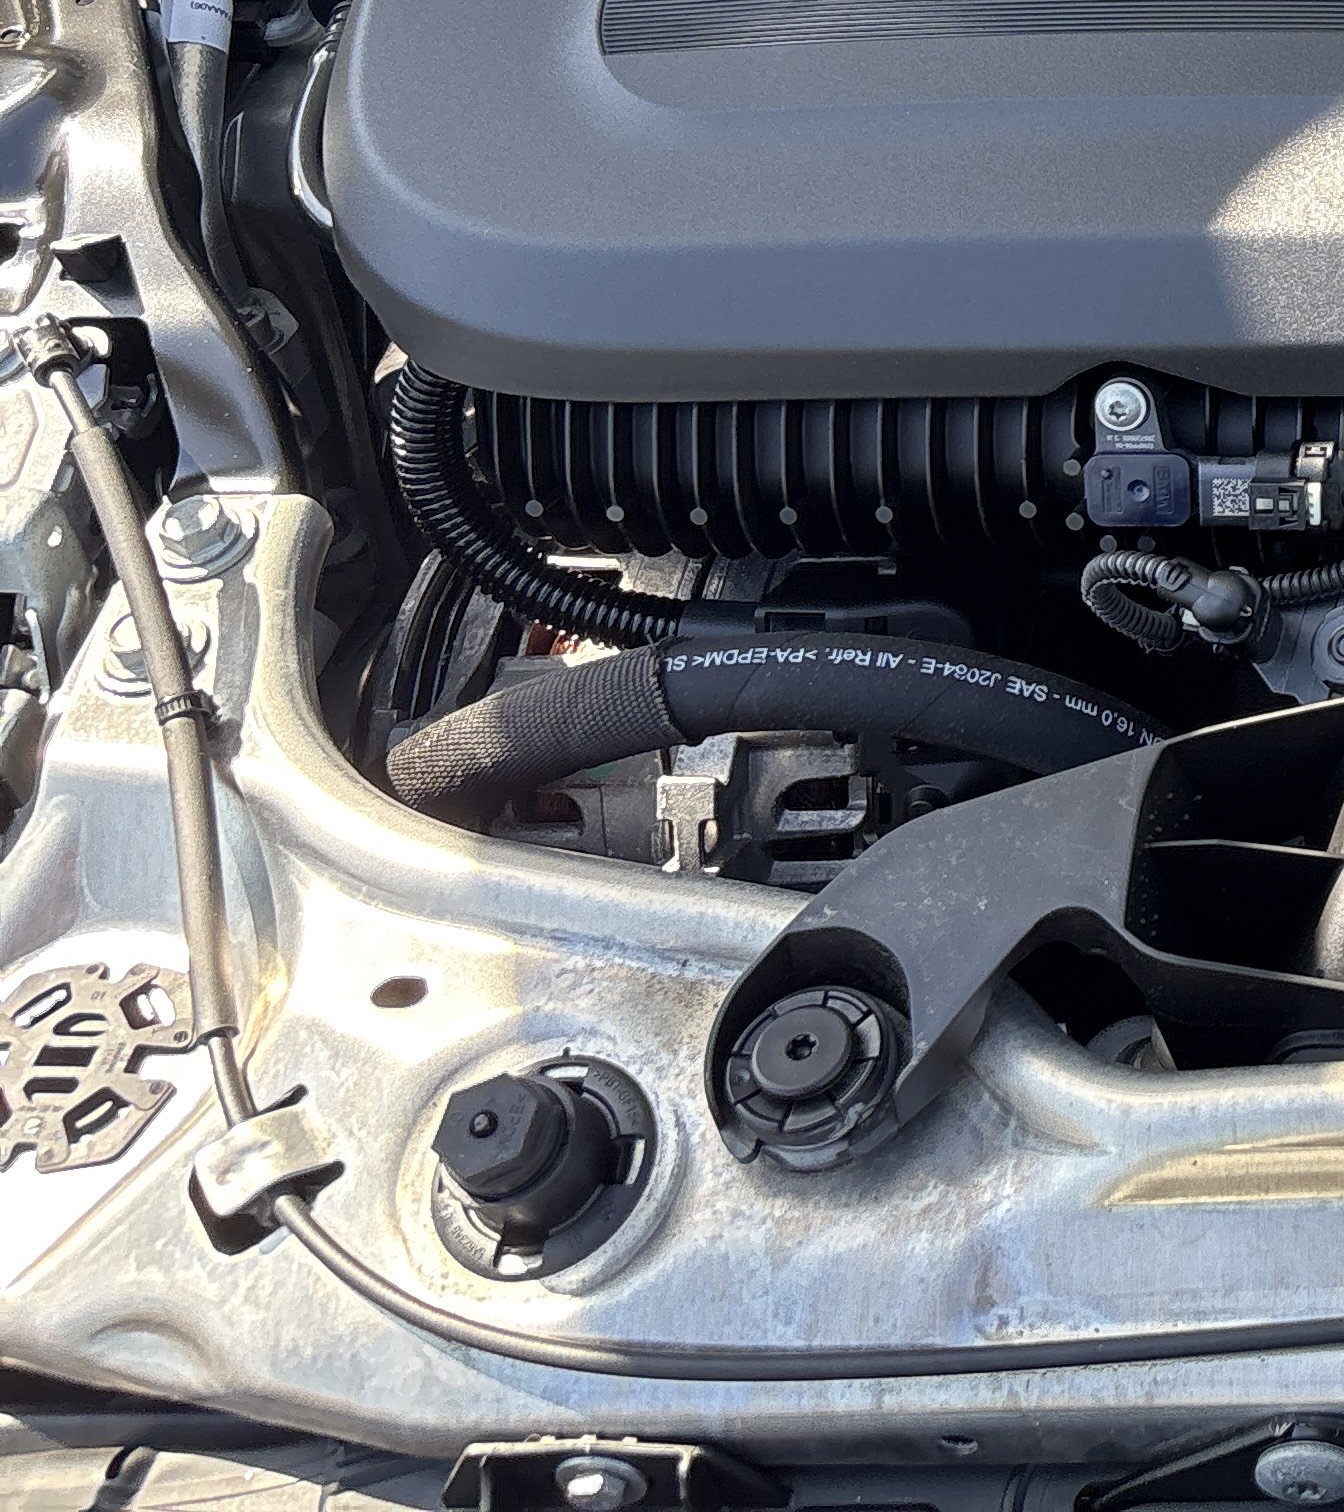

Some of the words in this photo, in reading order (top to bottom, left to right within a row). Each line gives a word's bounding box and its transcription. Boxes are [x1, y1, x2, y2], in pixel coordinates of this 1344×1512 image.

[825, 648, 866, 667] Refr.
[870, 651, 904, 669] All
[1005, 676, 1048, 702] SAE
[1065, 696, 1098, 718] mm
